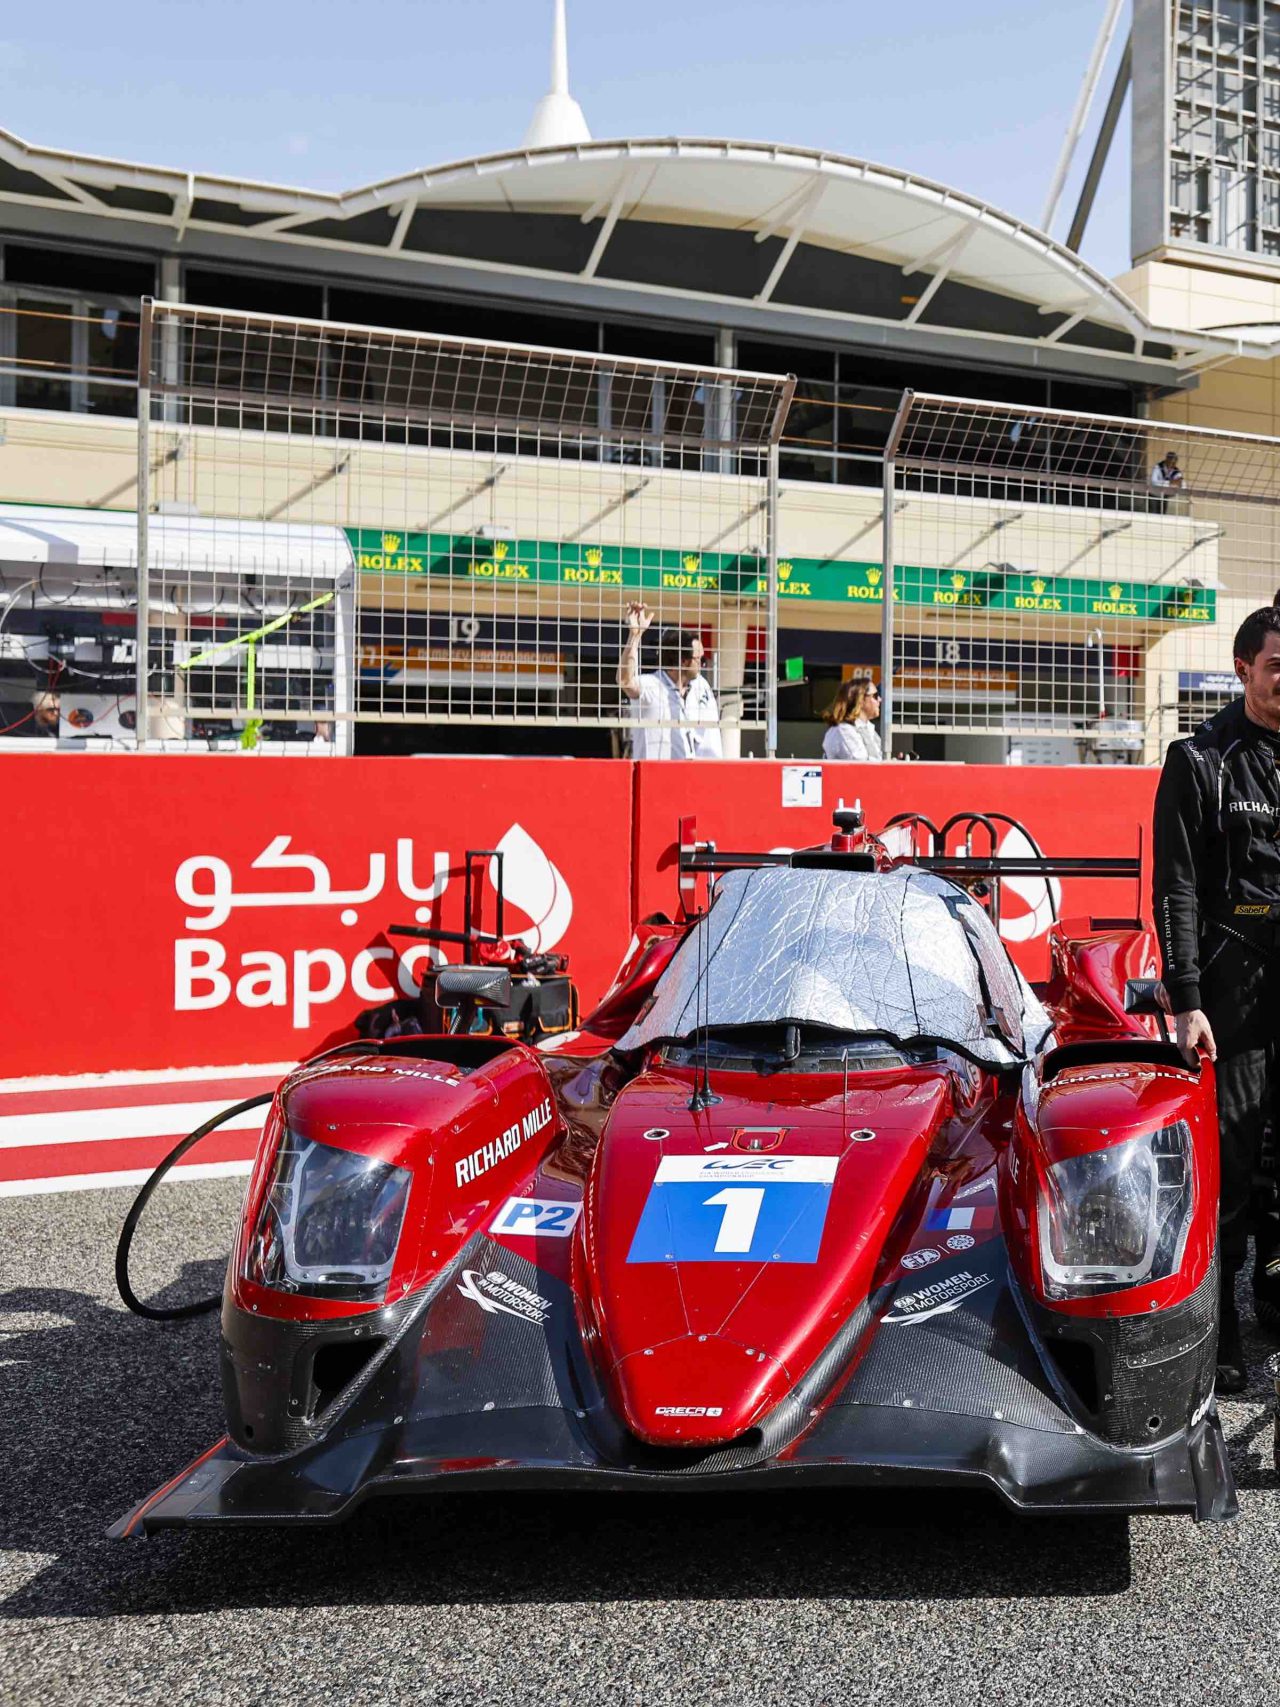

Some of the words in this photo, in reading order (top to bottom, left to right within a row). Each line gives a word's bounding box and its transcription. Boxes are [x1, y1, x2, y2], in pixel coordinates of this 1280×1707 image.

[358, 555, 424, 573] ROLEX
[469, 562, 530, 579] ROLEX
[564, 568, 624, 584] ROLEX
[663, 574, 719, 589] ROLEX
[933, 591, 982, 605] ROLEX
[1015, 597, 1062, 611] ROLEX
[1093, 601, 1137, 615] ROLEX
[1167, 607, 1211, 620] ROLEX
[449, 617, 480, 644] 19
[936, 641, 960, 664] 18
[1167, 940, 1176, 971] MILLE
[174, 937, 449, 1029] Bapco
[392, 1068, 460, 1088] MILLE
[1137, 1071, 1200, 1085] MILLE
[455, 1123, 521, 1188] RICHARD
[521, 1096, 553, 1141] MILLE
[702, 1158, 795, 1170] WEC
[501, 1203, 576, 1232] P2
[703, 1187, 766, 1253] 1
[902, 1250, 939, 1269] FIA
[501, 1279, 553, 1311] WOMEN
[902, 1305, 915, 1314] IN
[915, 1273, 990, 1312] MOTORSPORT
[912, 1271, 973, 1300] WOMEN
[483, 1283, 551, 1322] MOTORSPORT
[894, 1296, 915, 1308] FIA
[655, 1406, 707, 1415] ORECA
